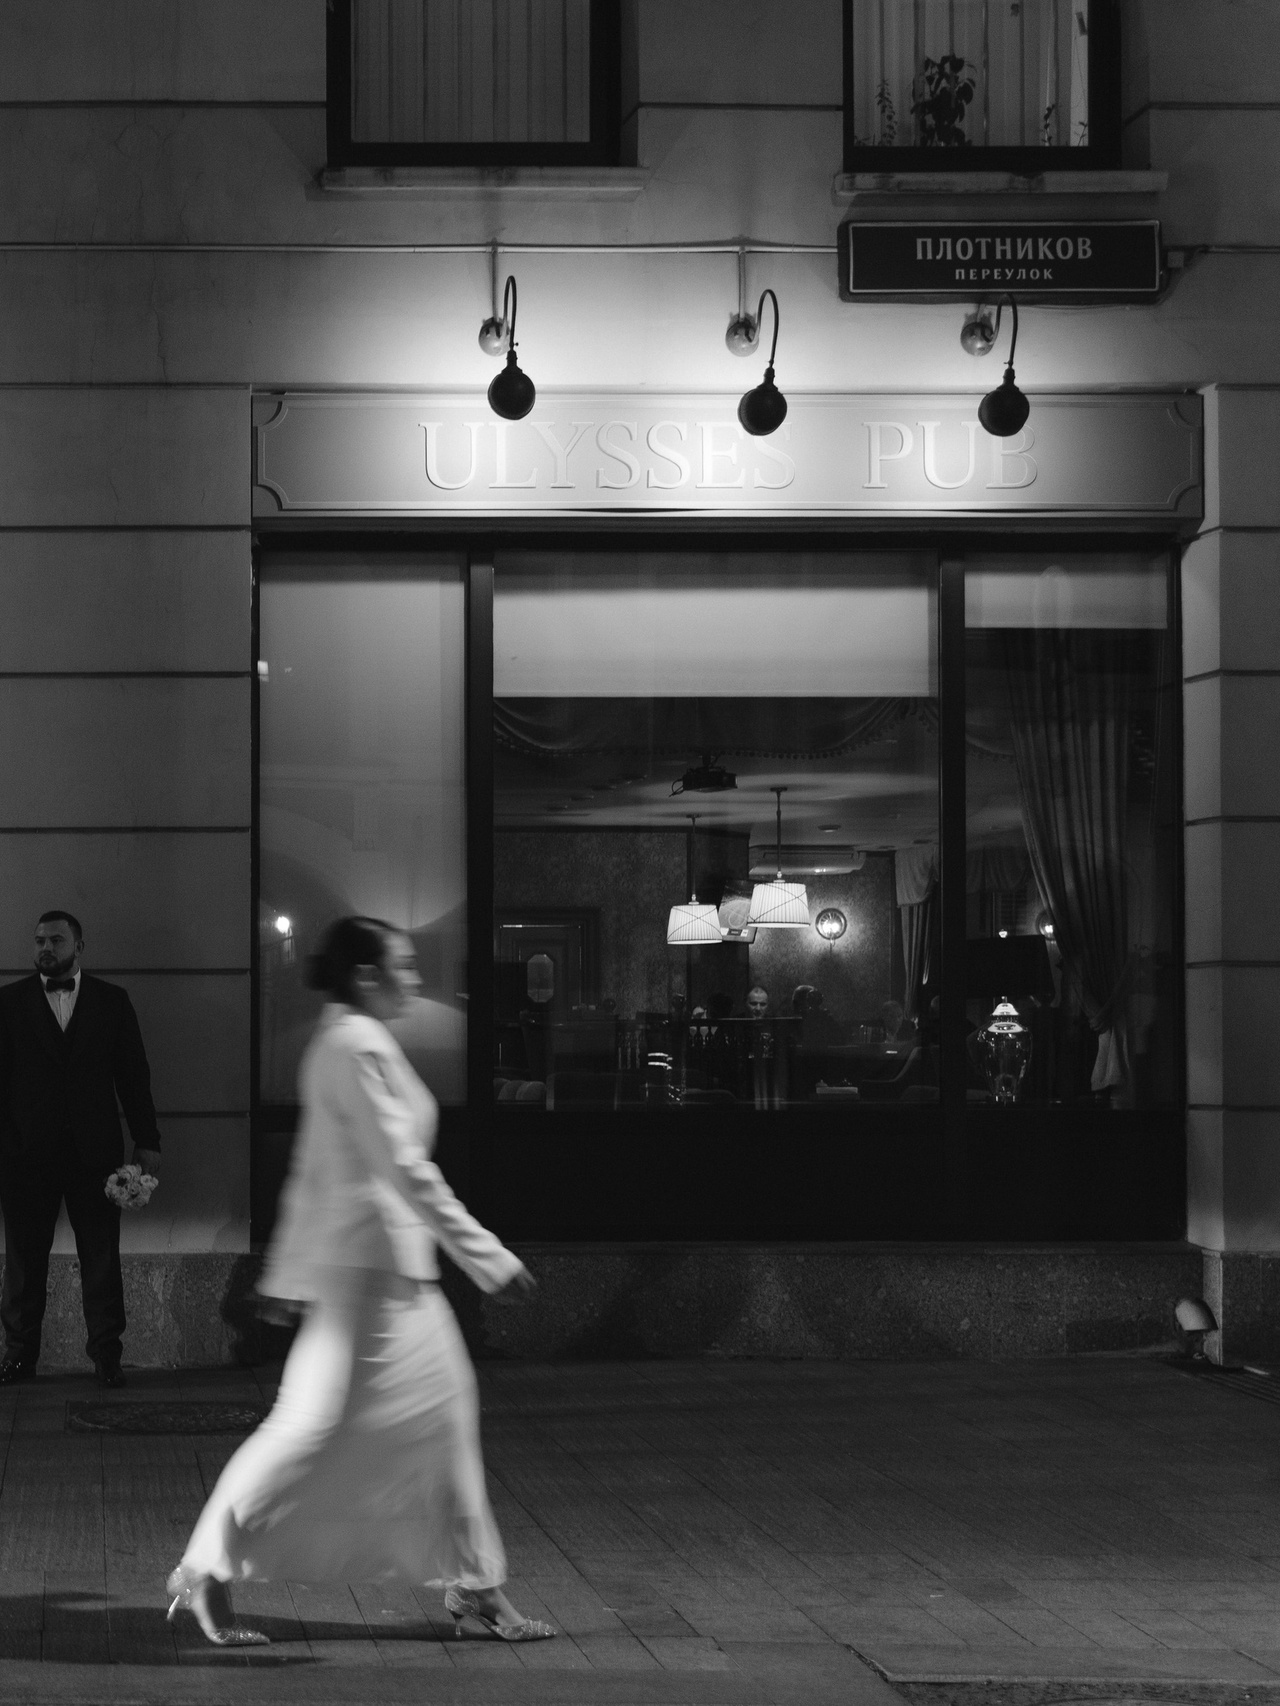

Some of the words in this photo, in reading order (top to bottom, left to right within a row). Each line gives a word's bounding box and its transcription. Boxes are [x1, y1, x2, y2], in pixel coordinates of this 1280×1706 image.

[915, 237, 1093, 261] ПЛОТНИКОВ
[955, 268, 1053, 281] ПЕРЕУЛОК
[418, 420, 796, 490] ULYSSES
[861, 420, 1038, 490] PUB
